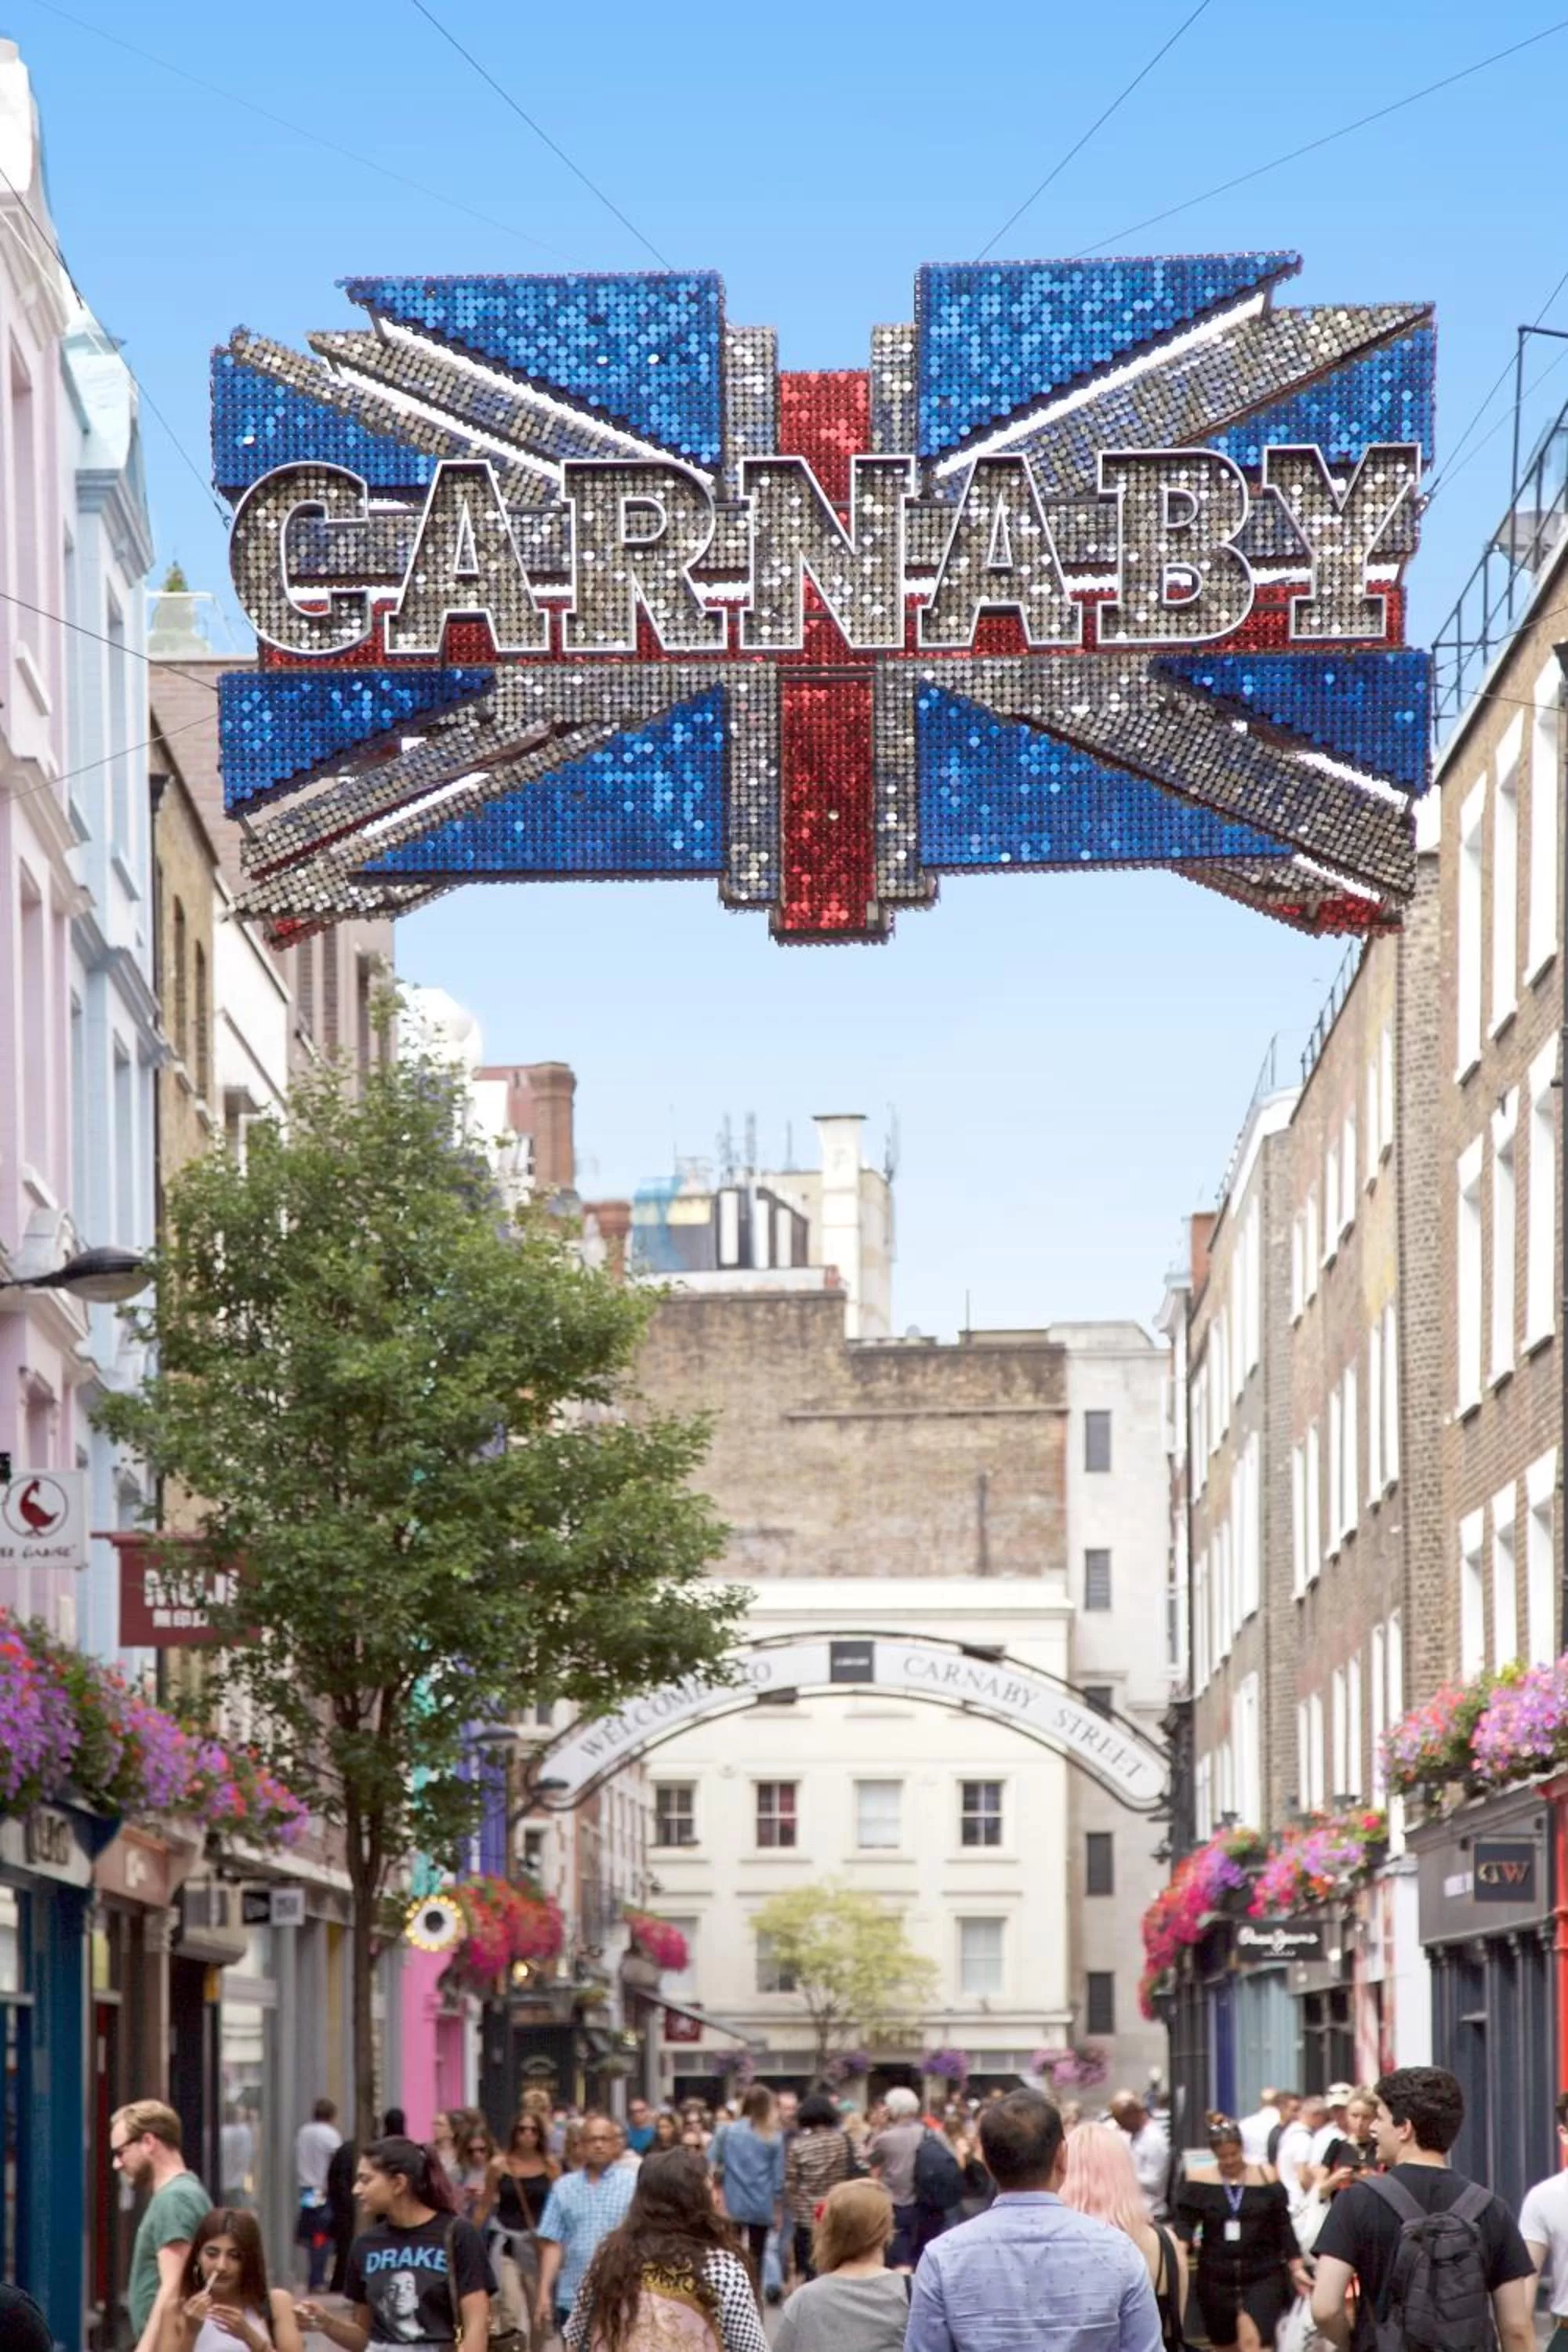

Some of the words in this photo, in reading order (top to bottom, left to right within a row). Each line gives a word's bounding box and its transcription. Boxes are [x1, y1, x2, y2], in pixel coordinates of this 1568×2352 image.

[229, 443, 1422, 655] CARNABY
[579, 1671, 711, 1759] WELCOME
[902, 1655, 1041, 1711] CARNABY
[1053, 1707, 1149, 1780] STREET
[365, 2246, 449, 2273] DRAKE
